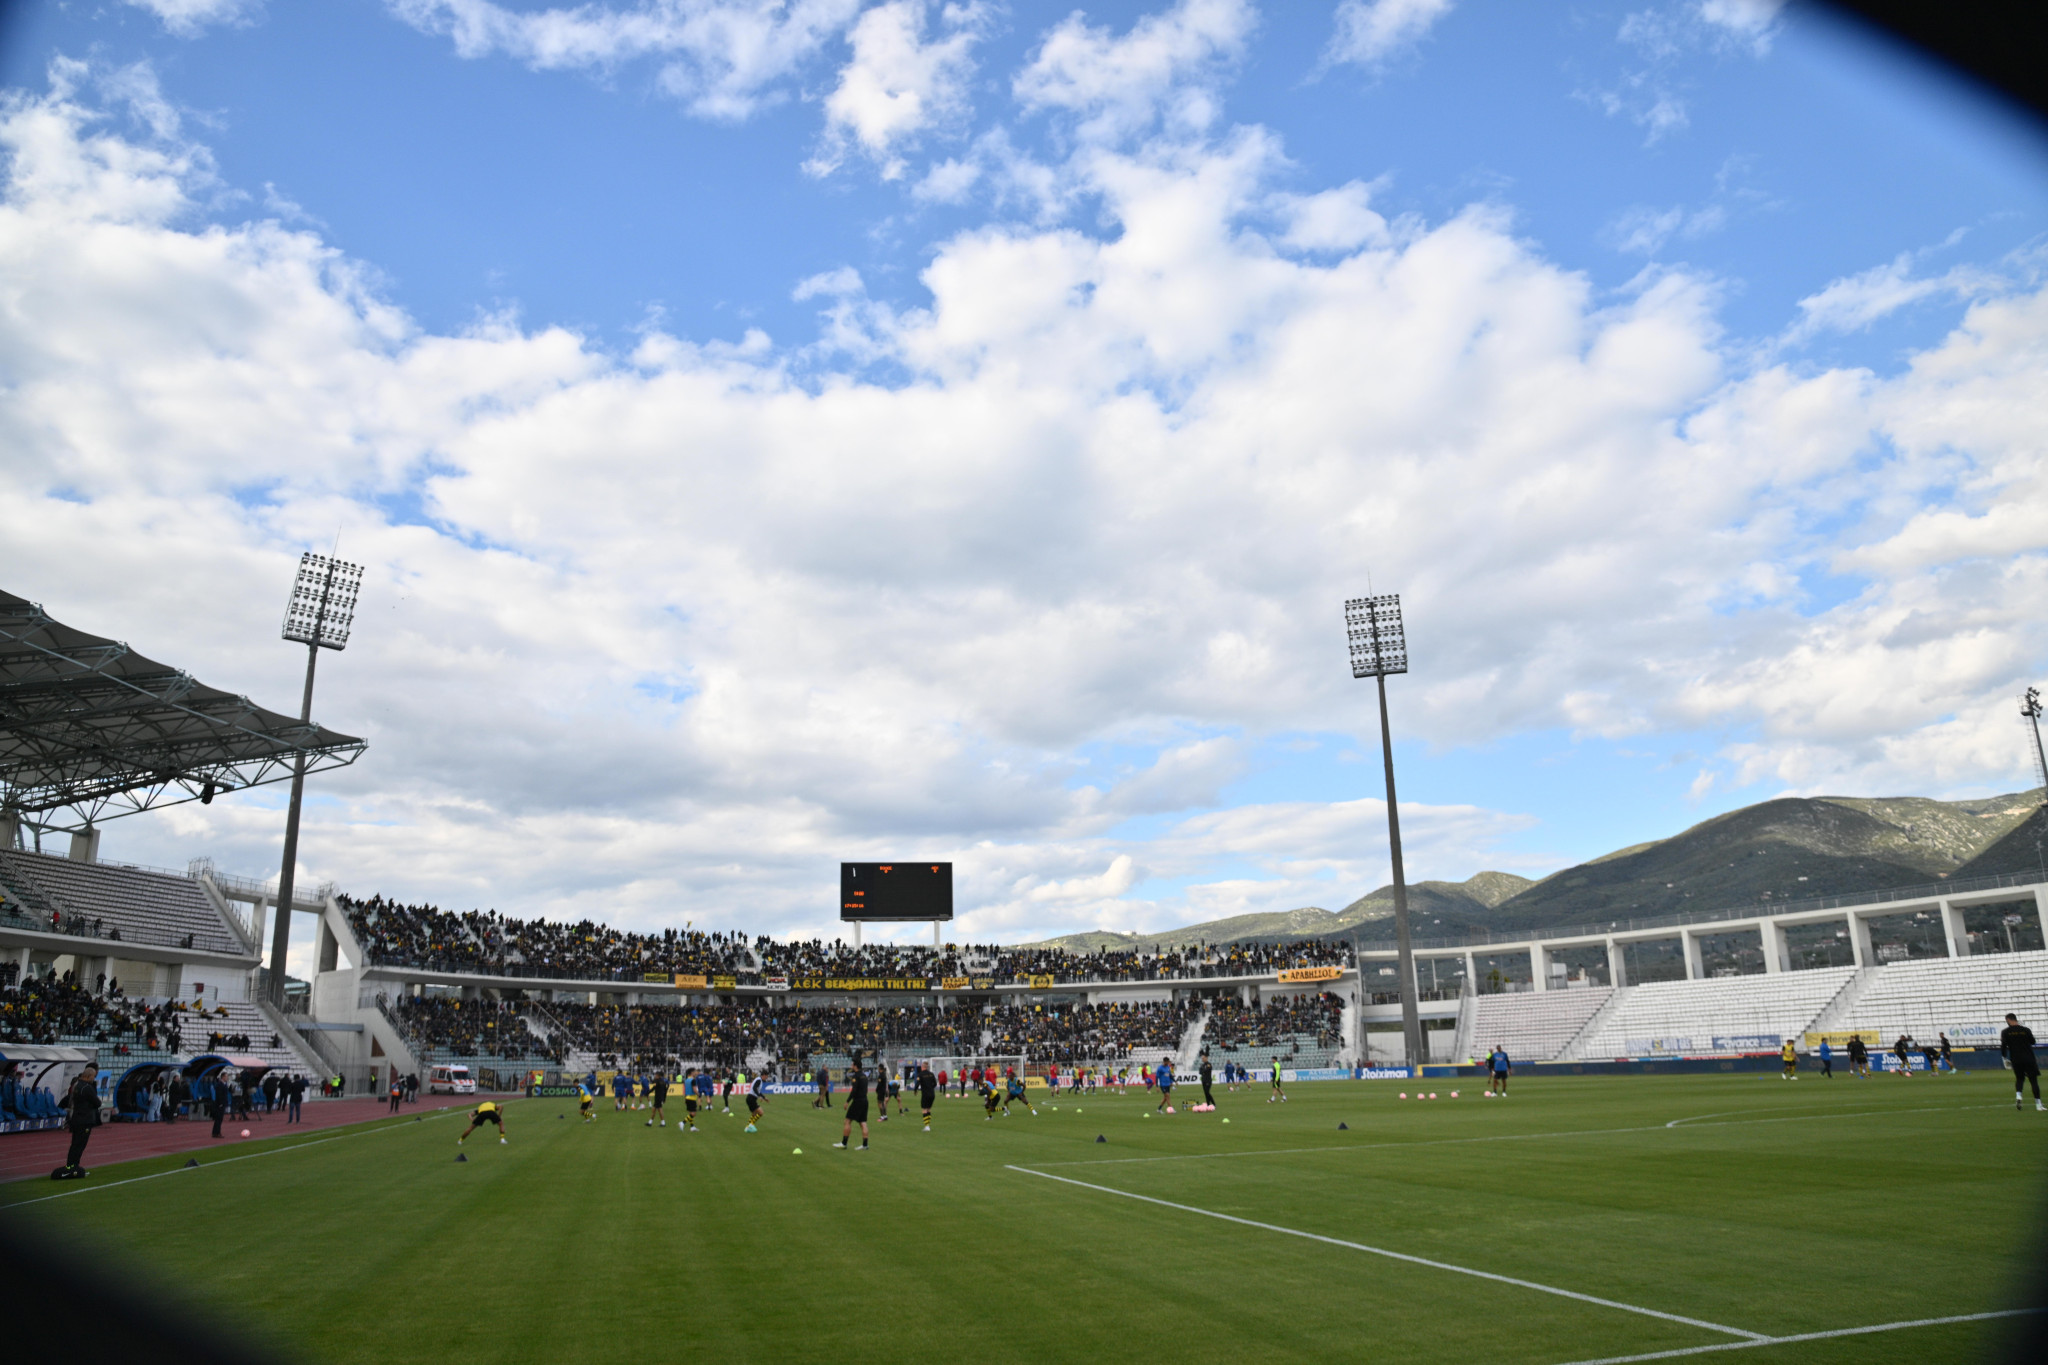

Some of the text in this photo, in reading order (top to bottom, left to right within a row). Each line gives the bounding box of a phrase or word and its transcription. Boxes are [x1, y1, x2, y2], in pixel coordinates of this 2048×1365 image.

[1961, 1026, 1997, 1035] volton
[1361, 1068, 1408, 1080] Stoiximan
[542, 1087, 577, 1096] COSMO
[773, 1083, 811, 1094] avance
